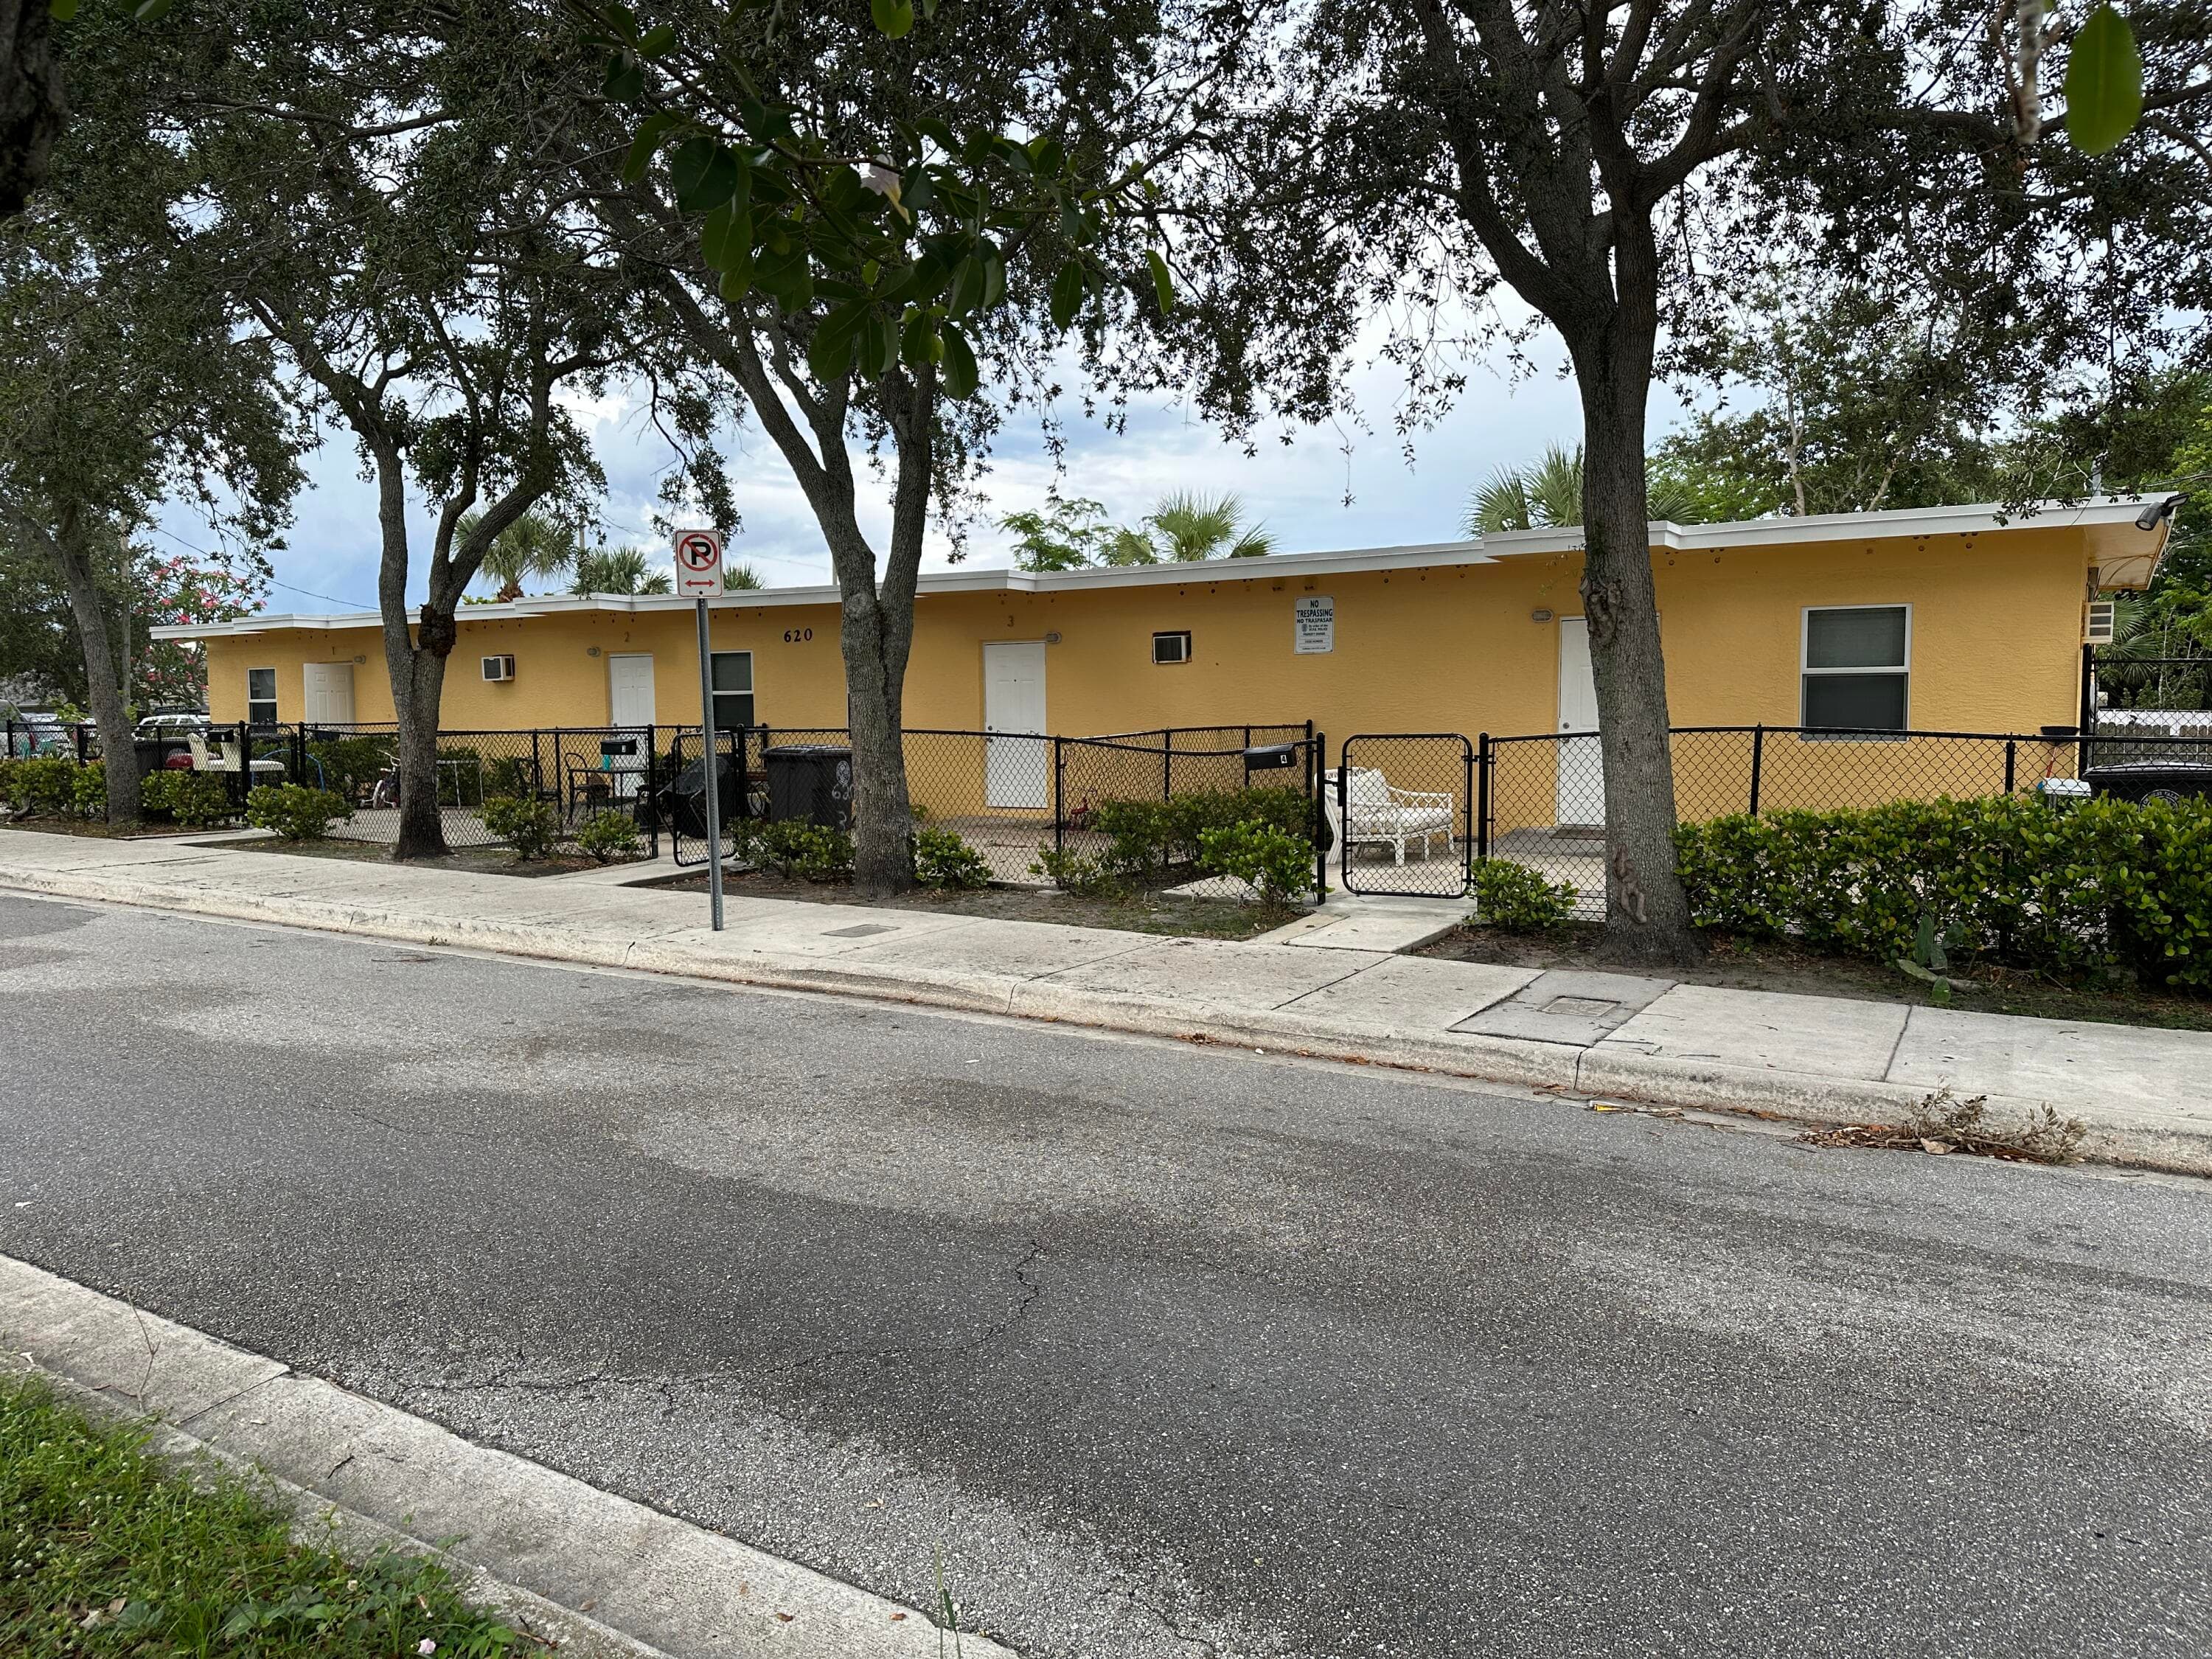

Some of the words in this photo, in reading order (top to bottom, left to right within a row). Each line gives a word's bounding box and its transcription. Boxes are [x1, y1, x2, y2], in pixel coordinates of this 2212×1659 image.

[691, 542, 712, 566] P
[1310, 600, 1319, 608] NO
[1296, 609, 1333, 618] TRESPASSING
[1007, 616, 1014, 627] 3
[624, 631, 630, 642] 2
[784, 628, 813, 642] 620
[1281, 755, 1287, 763] 4
